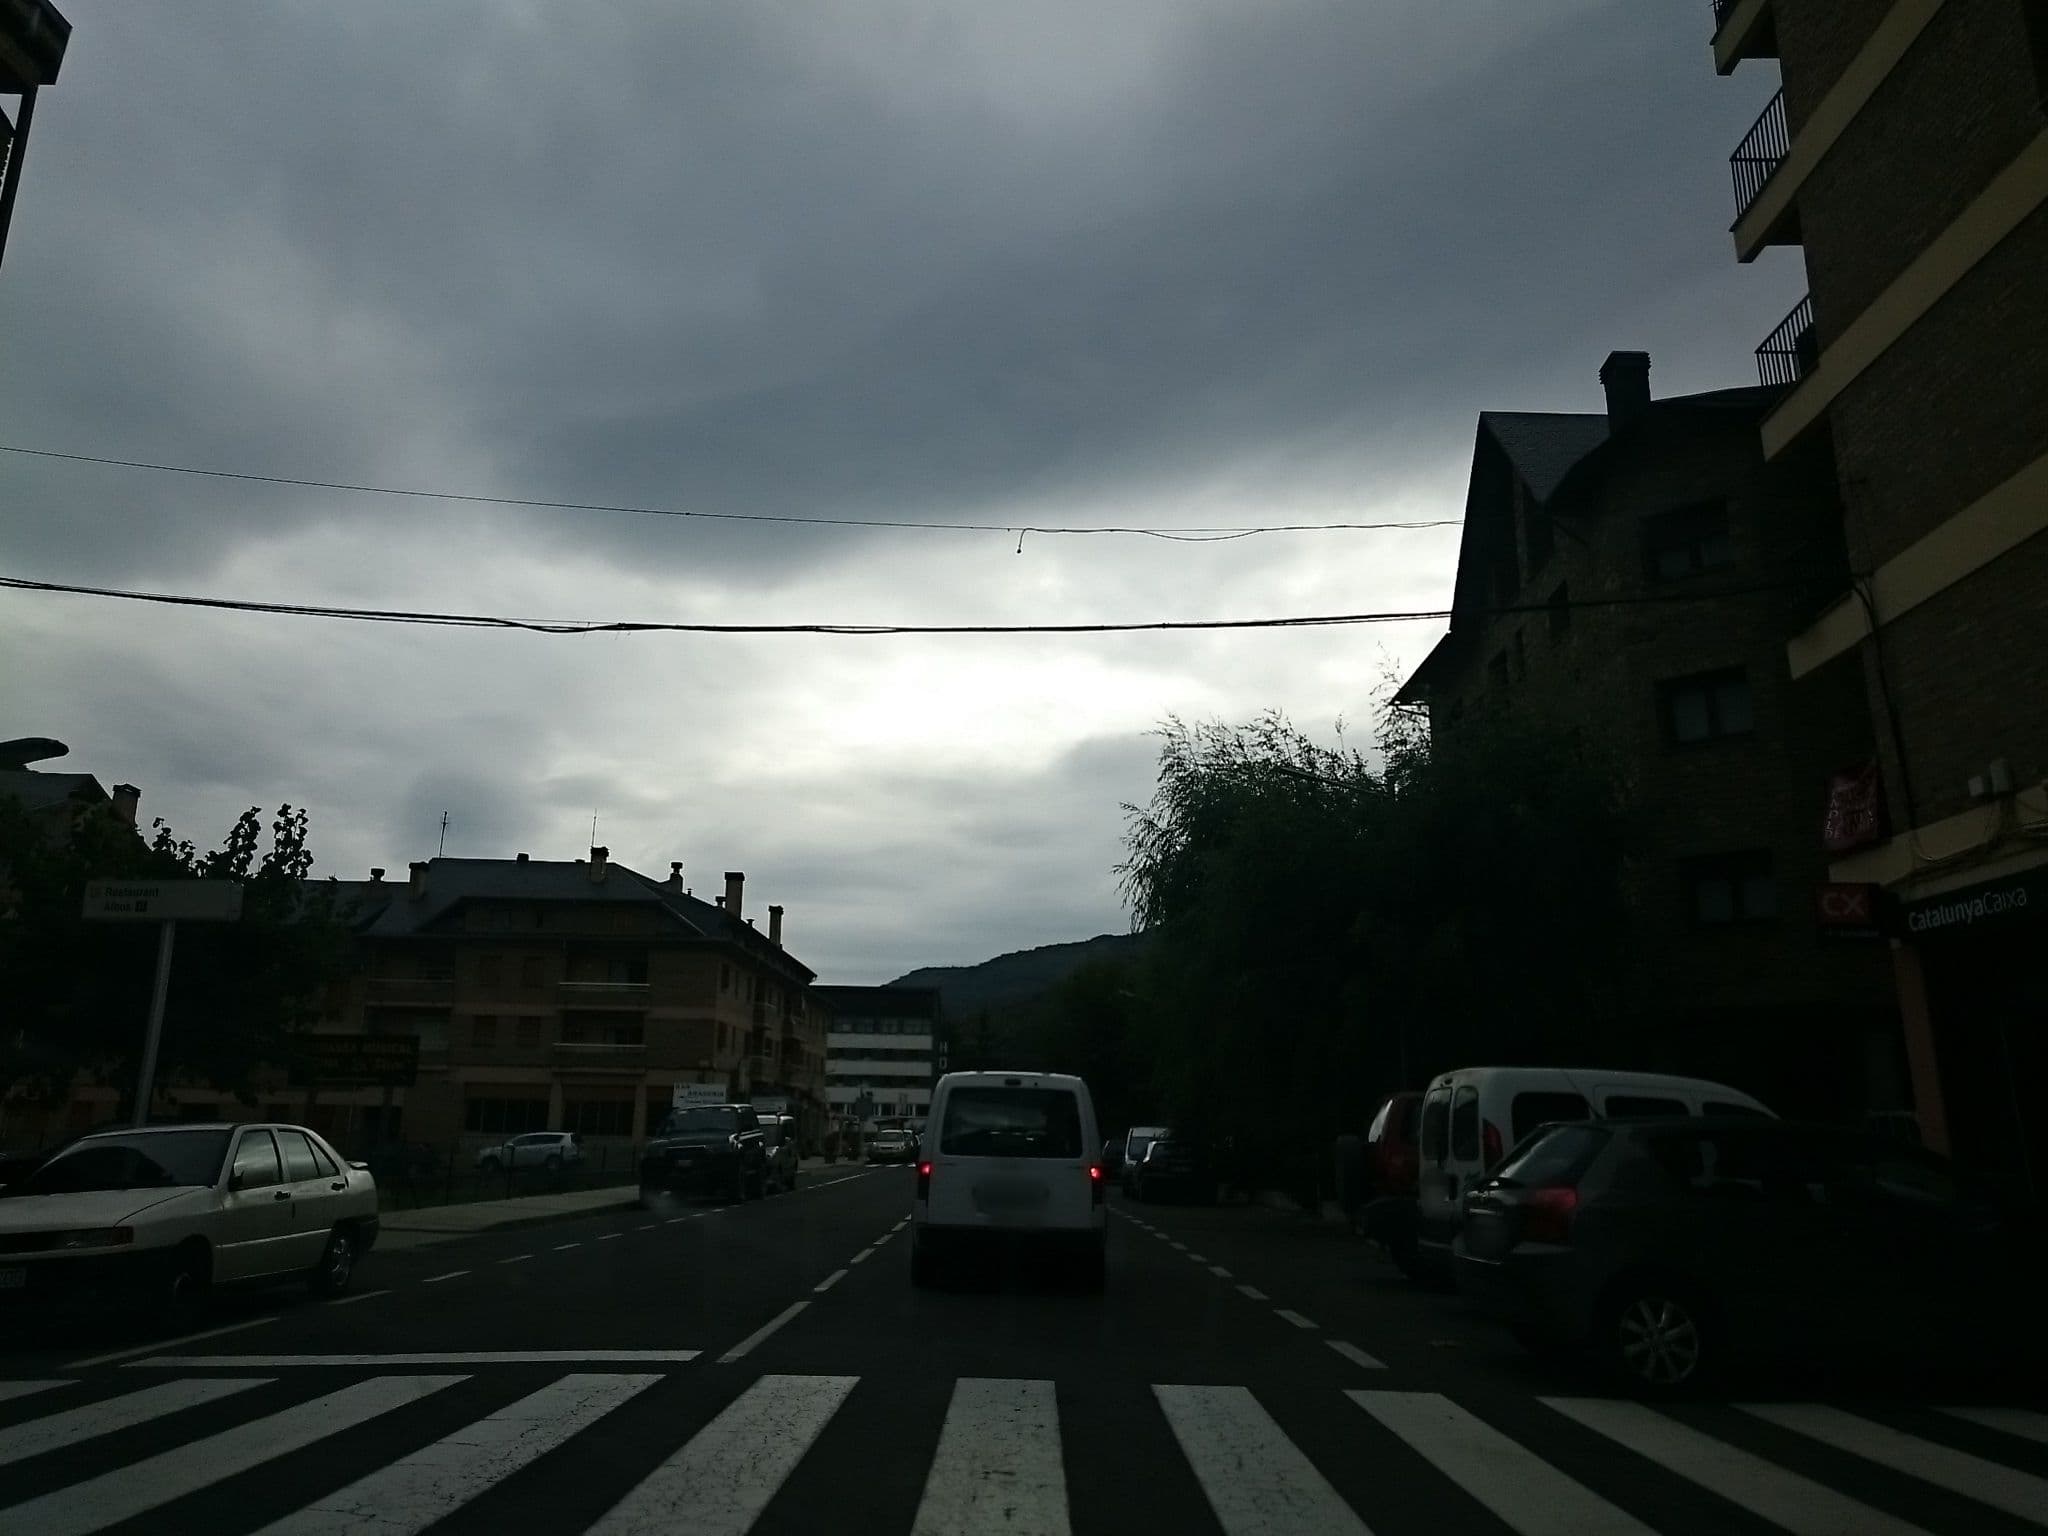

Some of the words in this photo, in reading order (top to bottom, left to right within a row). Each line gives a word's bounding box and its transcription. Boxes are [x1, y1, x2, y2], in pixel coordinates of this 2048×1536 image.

[104, 887, 159, 897] Restaurant
[1823, 893, 1864, 915] CX
[1908, 887, 2027, 931] CatalunyaCaixa
